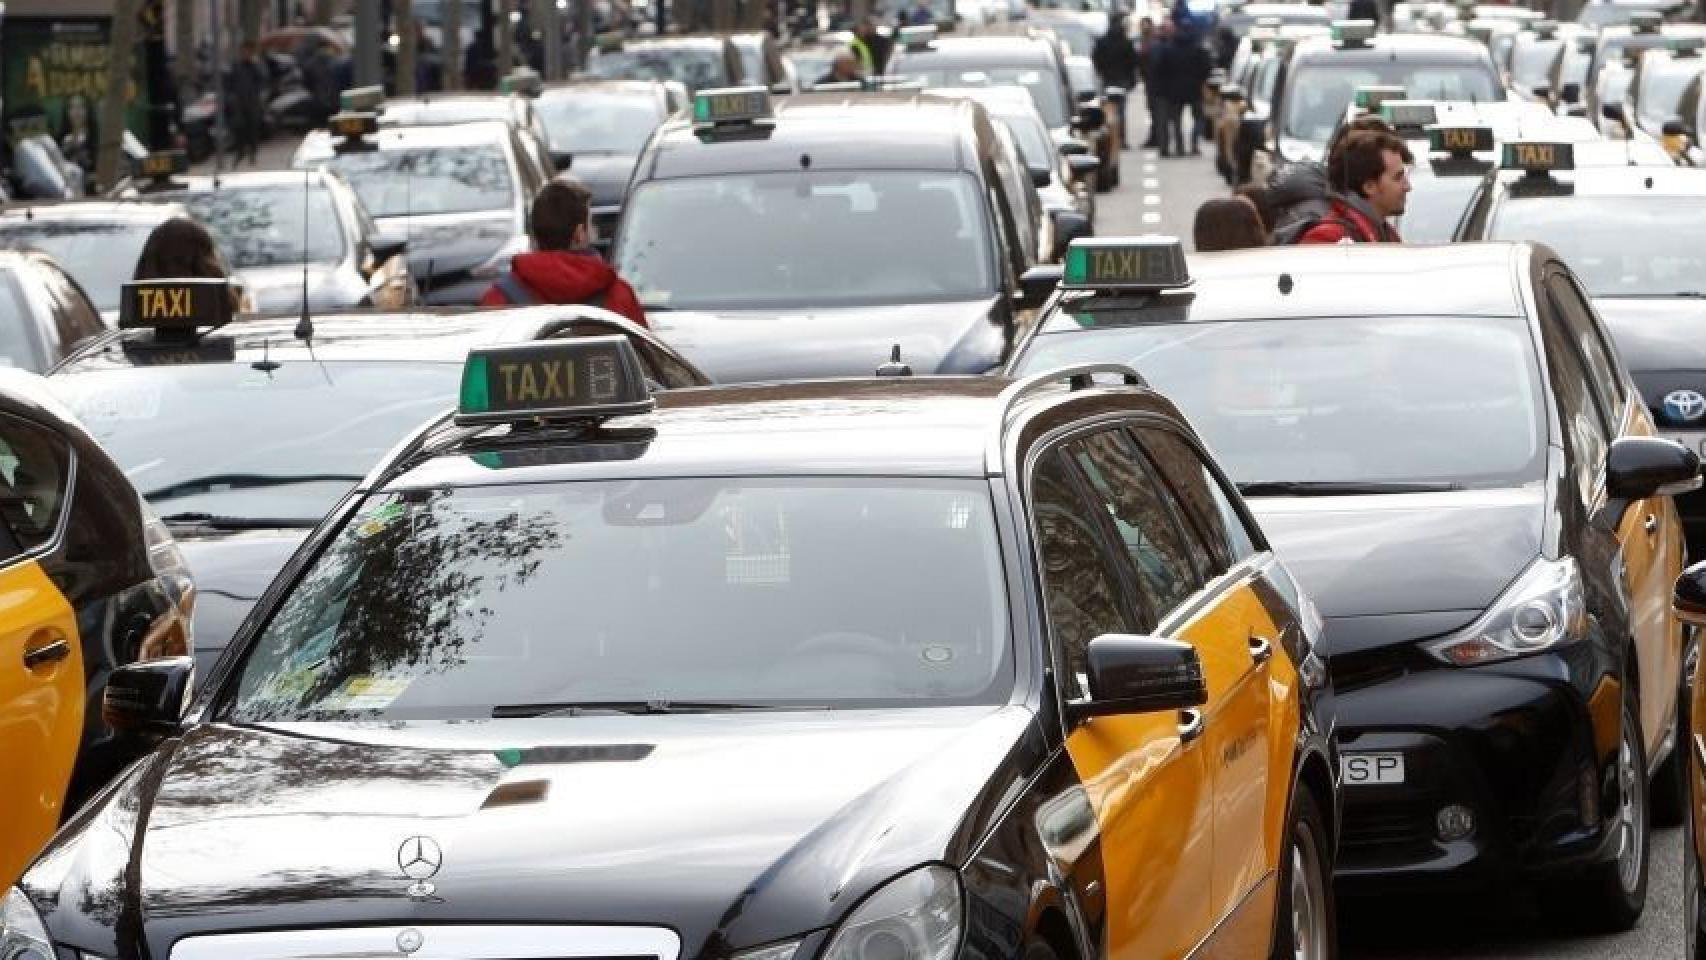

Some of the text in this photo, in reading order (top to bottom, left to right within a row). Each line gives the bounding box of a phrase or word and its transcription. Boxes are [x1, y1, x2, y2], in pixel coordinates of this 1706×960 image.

[1443, 128, 1477, 148] TAXI
[1516, 143, 1555, 166] TAXI
[1092, 247, 1140, 280] TAXI
[137, 287, 192, 319] TAXI
[499, 358, 575, 402] TAXI
[1347, 756, 1398, 782] SP
